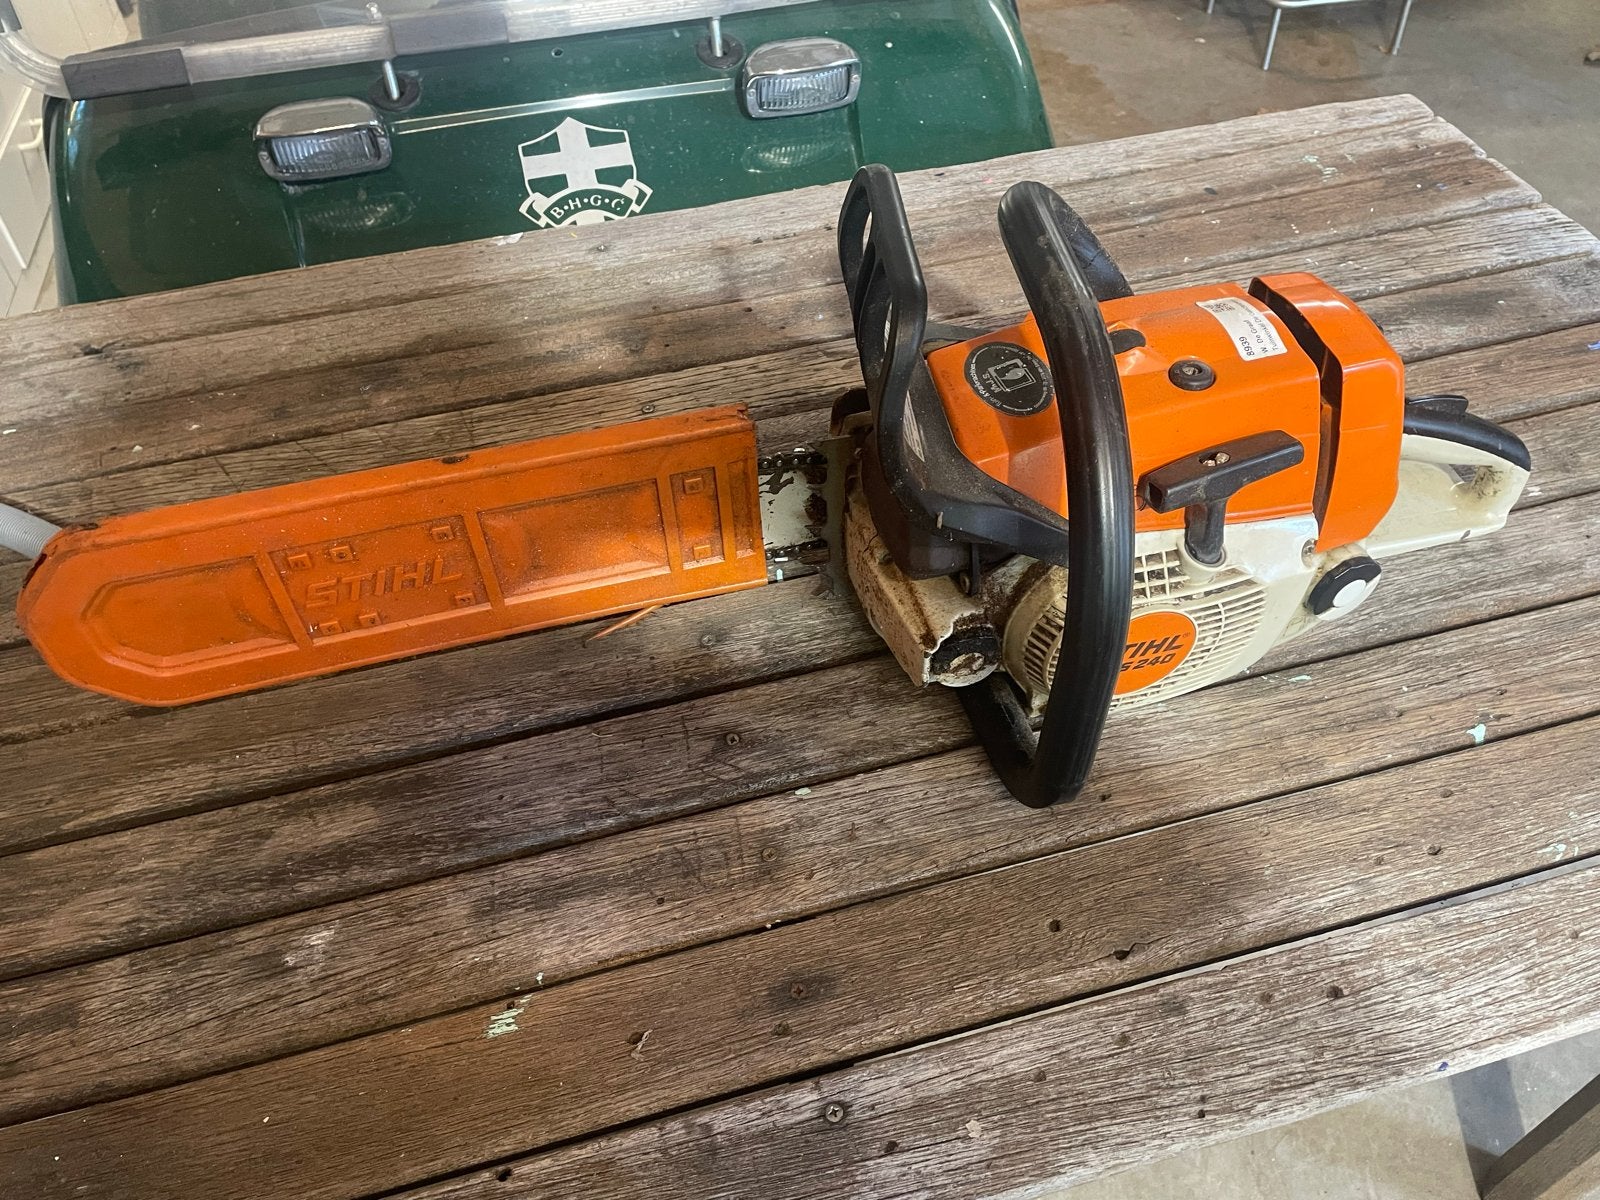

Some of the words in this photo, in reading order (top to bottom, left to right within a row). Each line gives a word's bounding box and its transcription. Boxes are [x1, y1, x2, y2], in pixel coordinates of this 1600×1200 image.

[1239, 336, 1255, 357] 8939
[306, 558, 462, 608] STIHL
[1124, 634, 1184, 659] TIHL
[1132, 653, 1176, 670] 240
